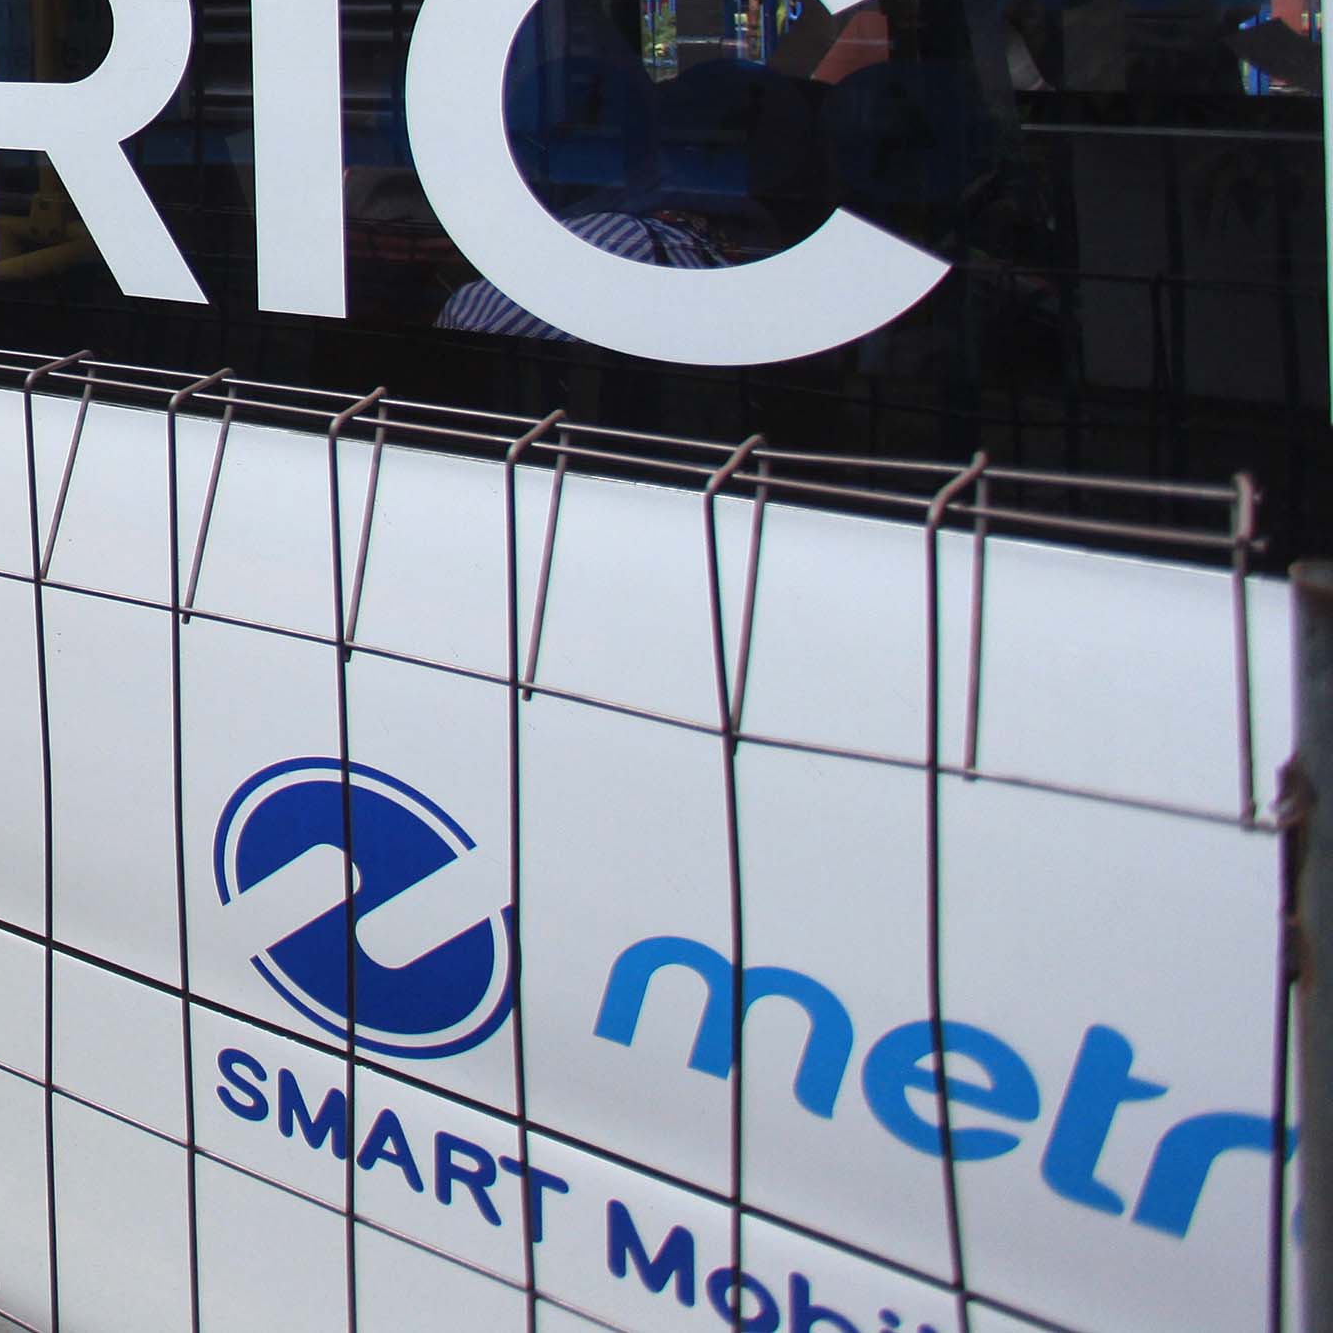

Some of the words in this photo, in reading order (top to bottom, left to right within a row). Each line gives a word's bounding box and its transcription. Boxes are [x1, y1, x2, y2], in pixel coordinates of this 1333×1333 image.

[215, 1046, 570, 1244] SMART
[606, 1198, 937, 1333] Mob
[593, 935, 1301, 1240] metr
